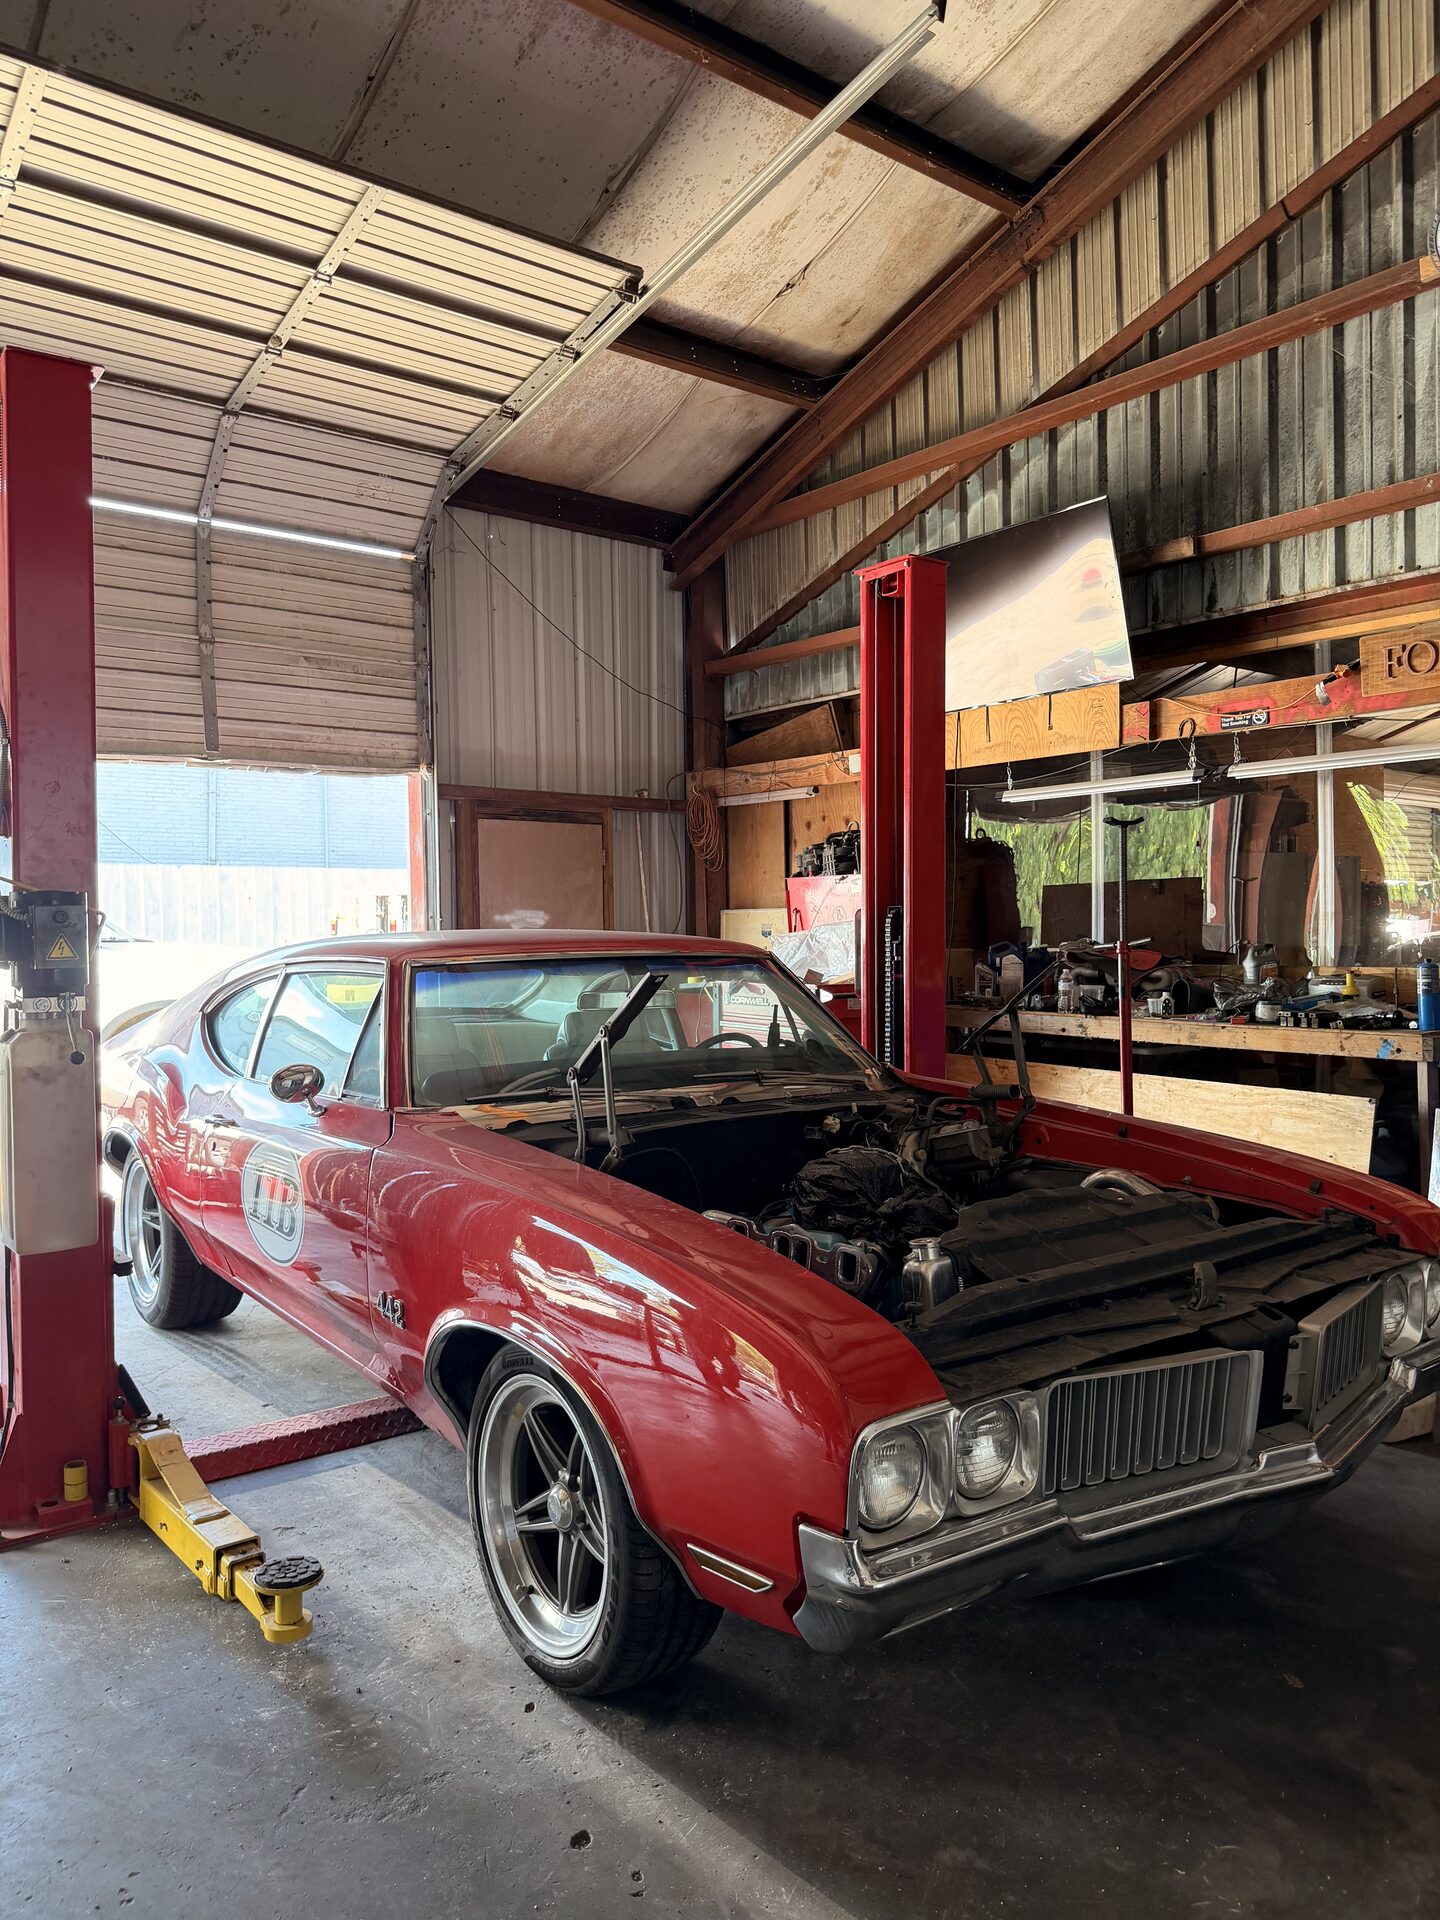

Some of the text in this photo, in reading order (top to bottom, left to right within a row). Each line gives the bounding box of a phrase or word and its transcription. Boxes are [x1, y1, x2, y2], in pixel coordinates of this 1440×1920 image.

[1380, 640, 1440, 680] FO
[730, 996, 770, 1006] CORNWELL
[377, 1291, 405, 1329] 442
